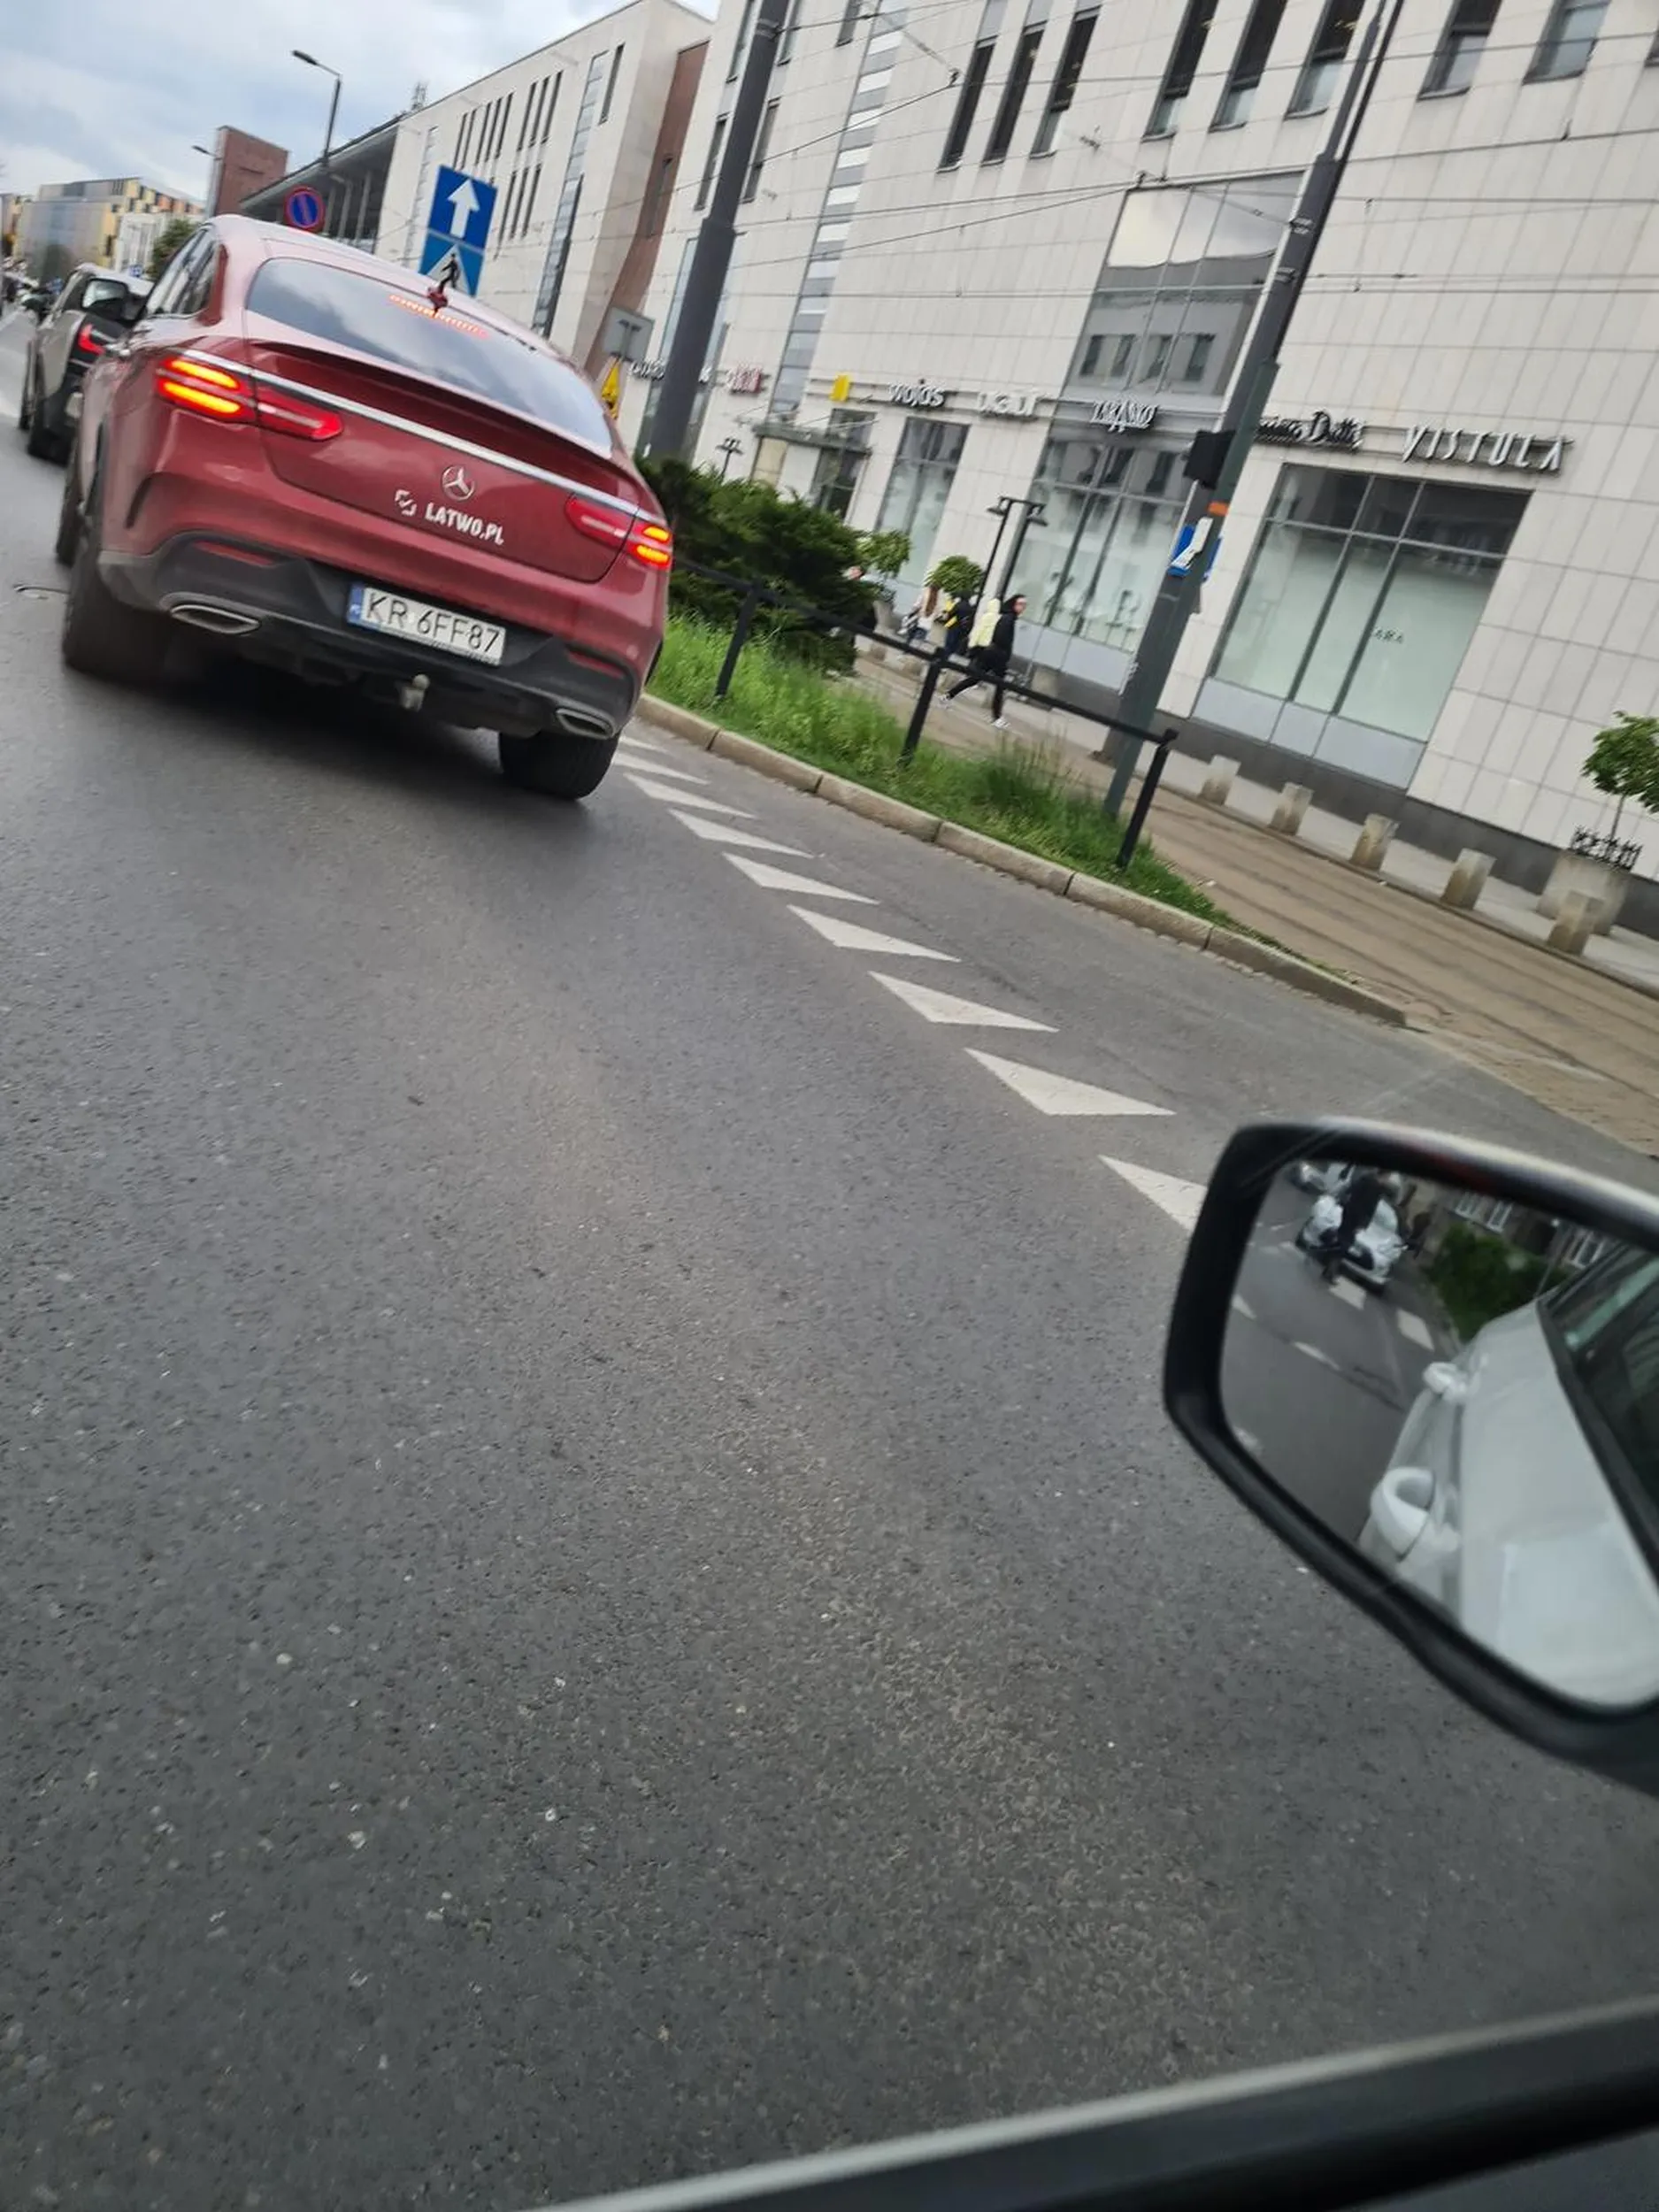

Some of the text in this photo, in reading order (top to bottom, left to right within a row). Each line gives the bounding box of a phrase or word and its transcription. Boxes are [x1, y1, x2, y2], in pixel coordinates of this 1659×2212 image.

[1402, 423, 1571, 472] VISTULA
[366, 592, 408, 628] KR
[417, 609, 500, 653] 6FF87
